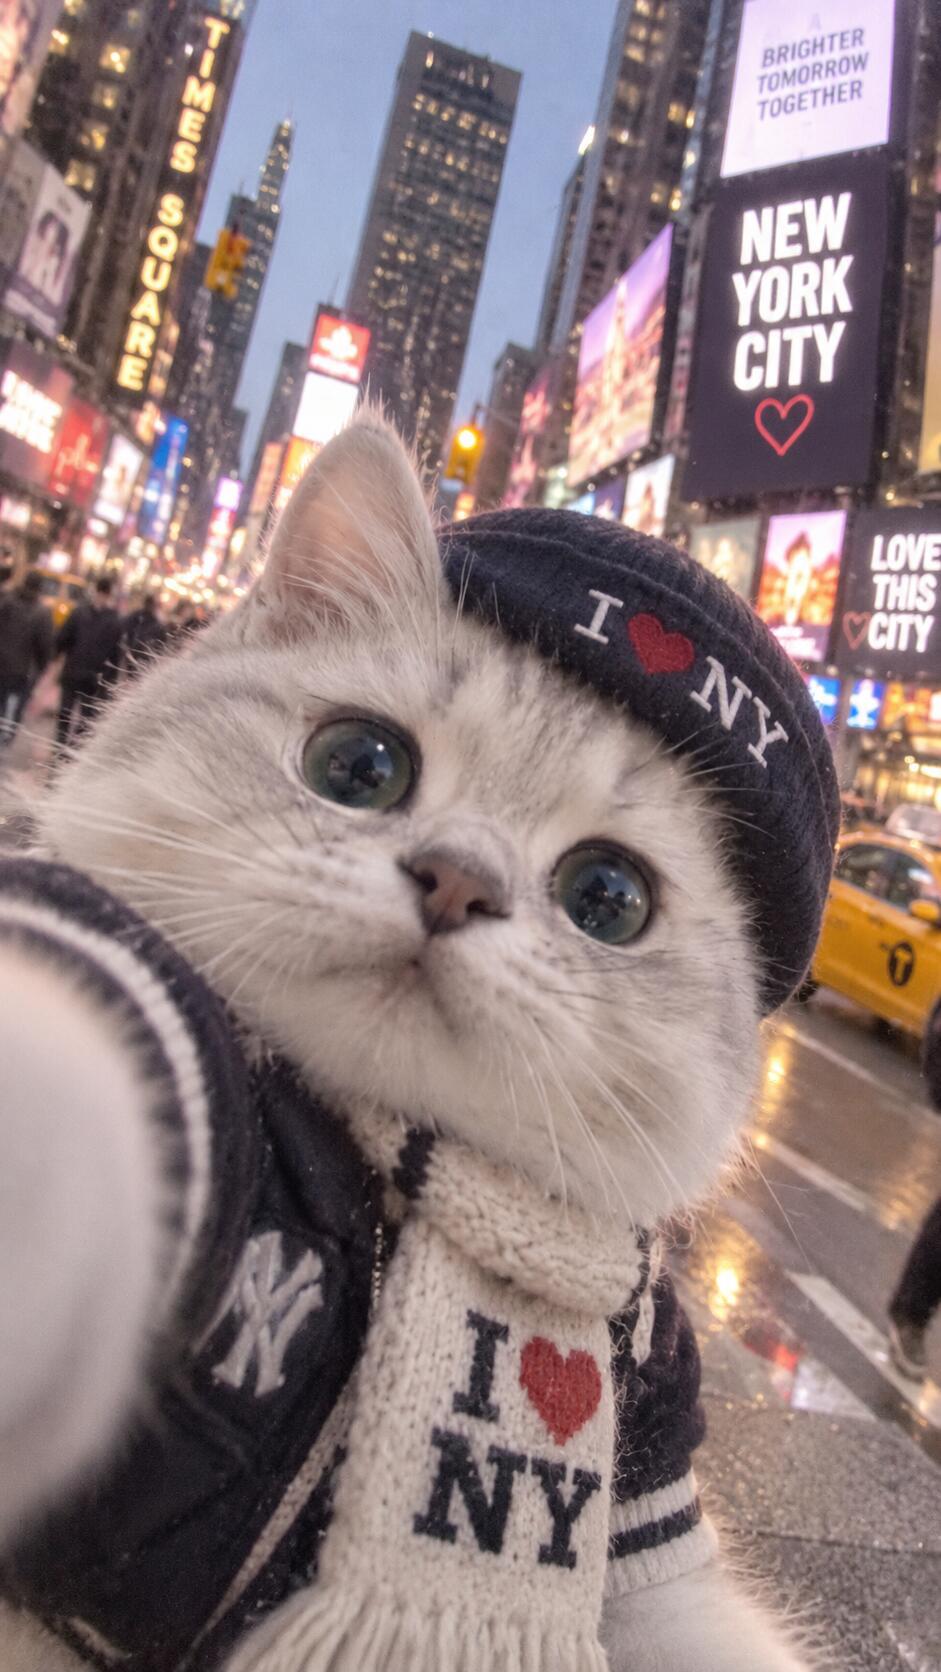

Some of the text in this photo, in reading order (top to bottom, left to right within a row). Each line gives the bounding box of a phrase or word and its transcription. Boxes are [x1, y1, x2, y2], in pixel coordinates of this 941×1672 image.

[757, 52, 869, 94] TOMORROW
[761, 28, 865, 68] BRIGHTER
[757, 80, 863, 121] TOGETHER
[116, 17, 230, 392] TIMES SQUARE
[740, 192, 852, 265] NEW
[732, 255, 854, 327] YORK
[733, 321, 847, 391] CITY
[871, 533, 941, 571] LOVE
[873, 573, 937, 612] THIS
[868, 614, 934, 653] CITY
[574, 589, 790, 768] I NY
[211, 1230, 324, 1398] NY
[452, 1309, 509, 1423] I
[413, 1428, 602, 1570] NY
